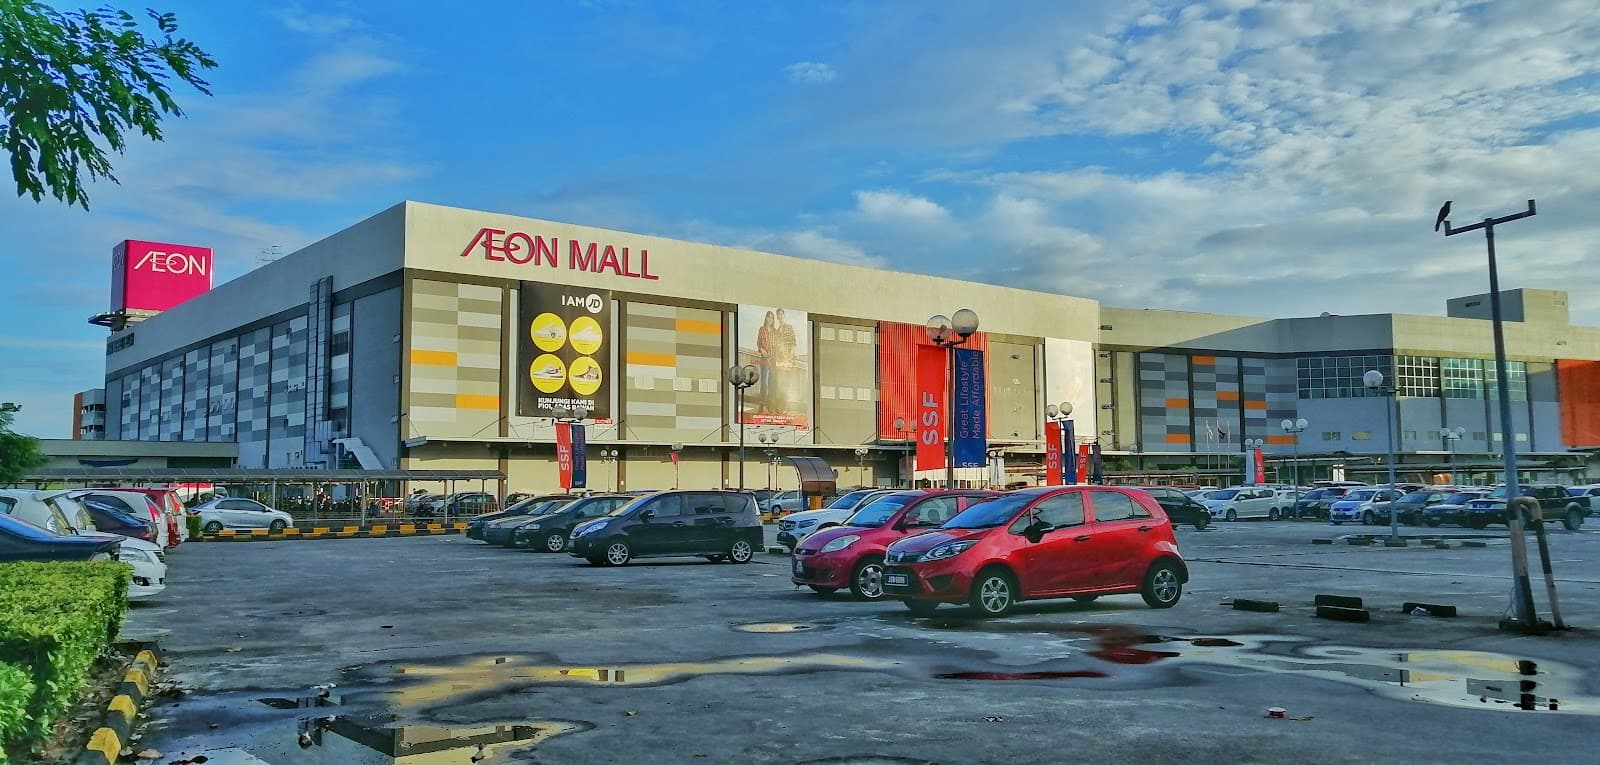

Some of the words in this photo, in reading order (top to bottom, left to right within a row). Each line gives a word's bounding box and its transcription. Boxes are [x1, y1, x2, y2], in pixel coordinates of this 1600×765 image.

[569, 239, 659, 280] MALL
[561, 294, 566, 306] I
[567, 295, 585, 308] AM
[960, 361, 970, 407] Lifestyle
[971, 351, 980, 407] Affordable
[922, 391, 939, 446] SSF
[960, 409, 969, 438] Great
[972, 411, 981, 439] Made
[559, 445, 570, 471] SSF
[1048, 443, 1058, 470] SSF
